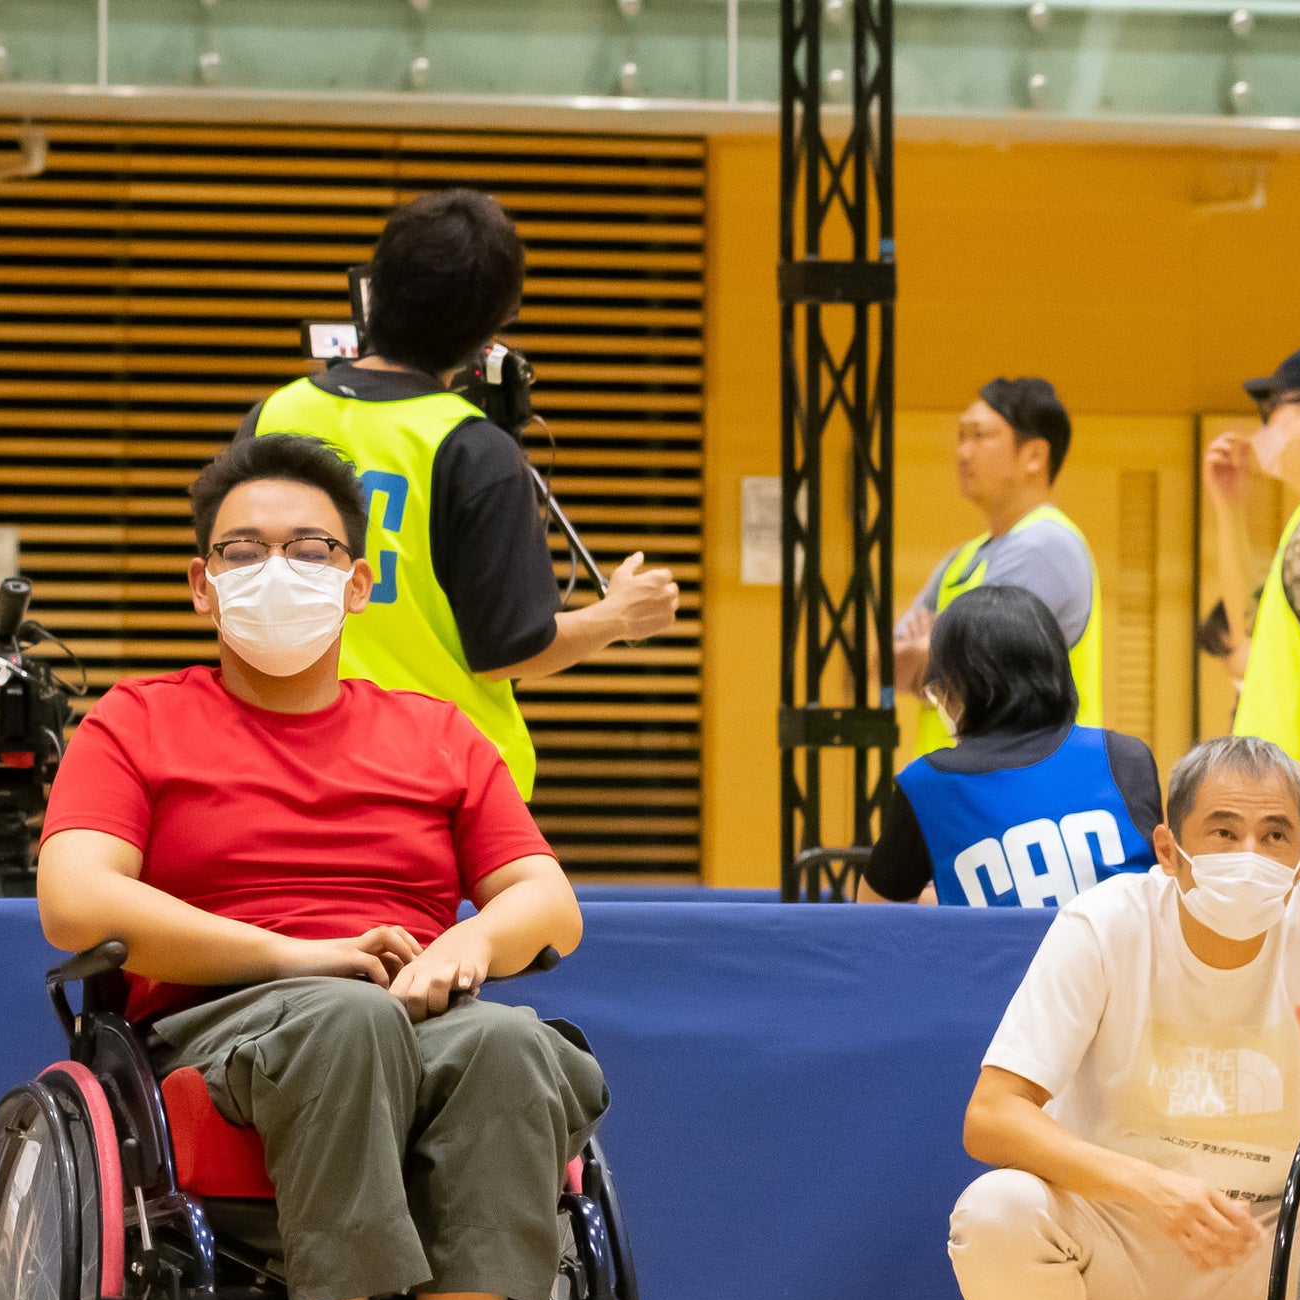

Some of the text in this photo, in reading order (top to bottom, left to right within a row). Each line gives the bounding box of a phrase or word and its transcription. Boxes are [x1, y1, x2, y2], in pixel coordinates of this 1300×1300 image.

[1188, 1046, 1237, 1072] THE
[1147, 1063, 1237, 1096] NORTH
[1166, 1093, 1235, 1118] FACE
